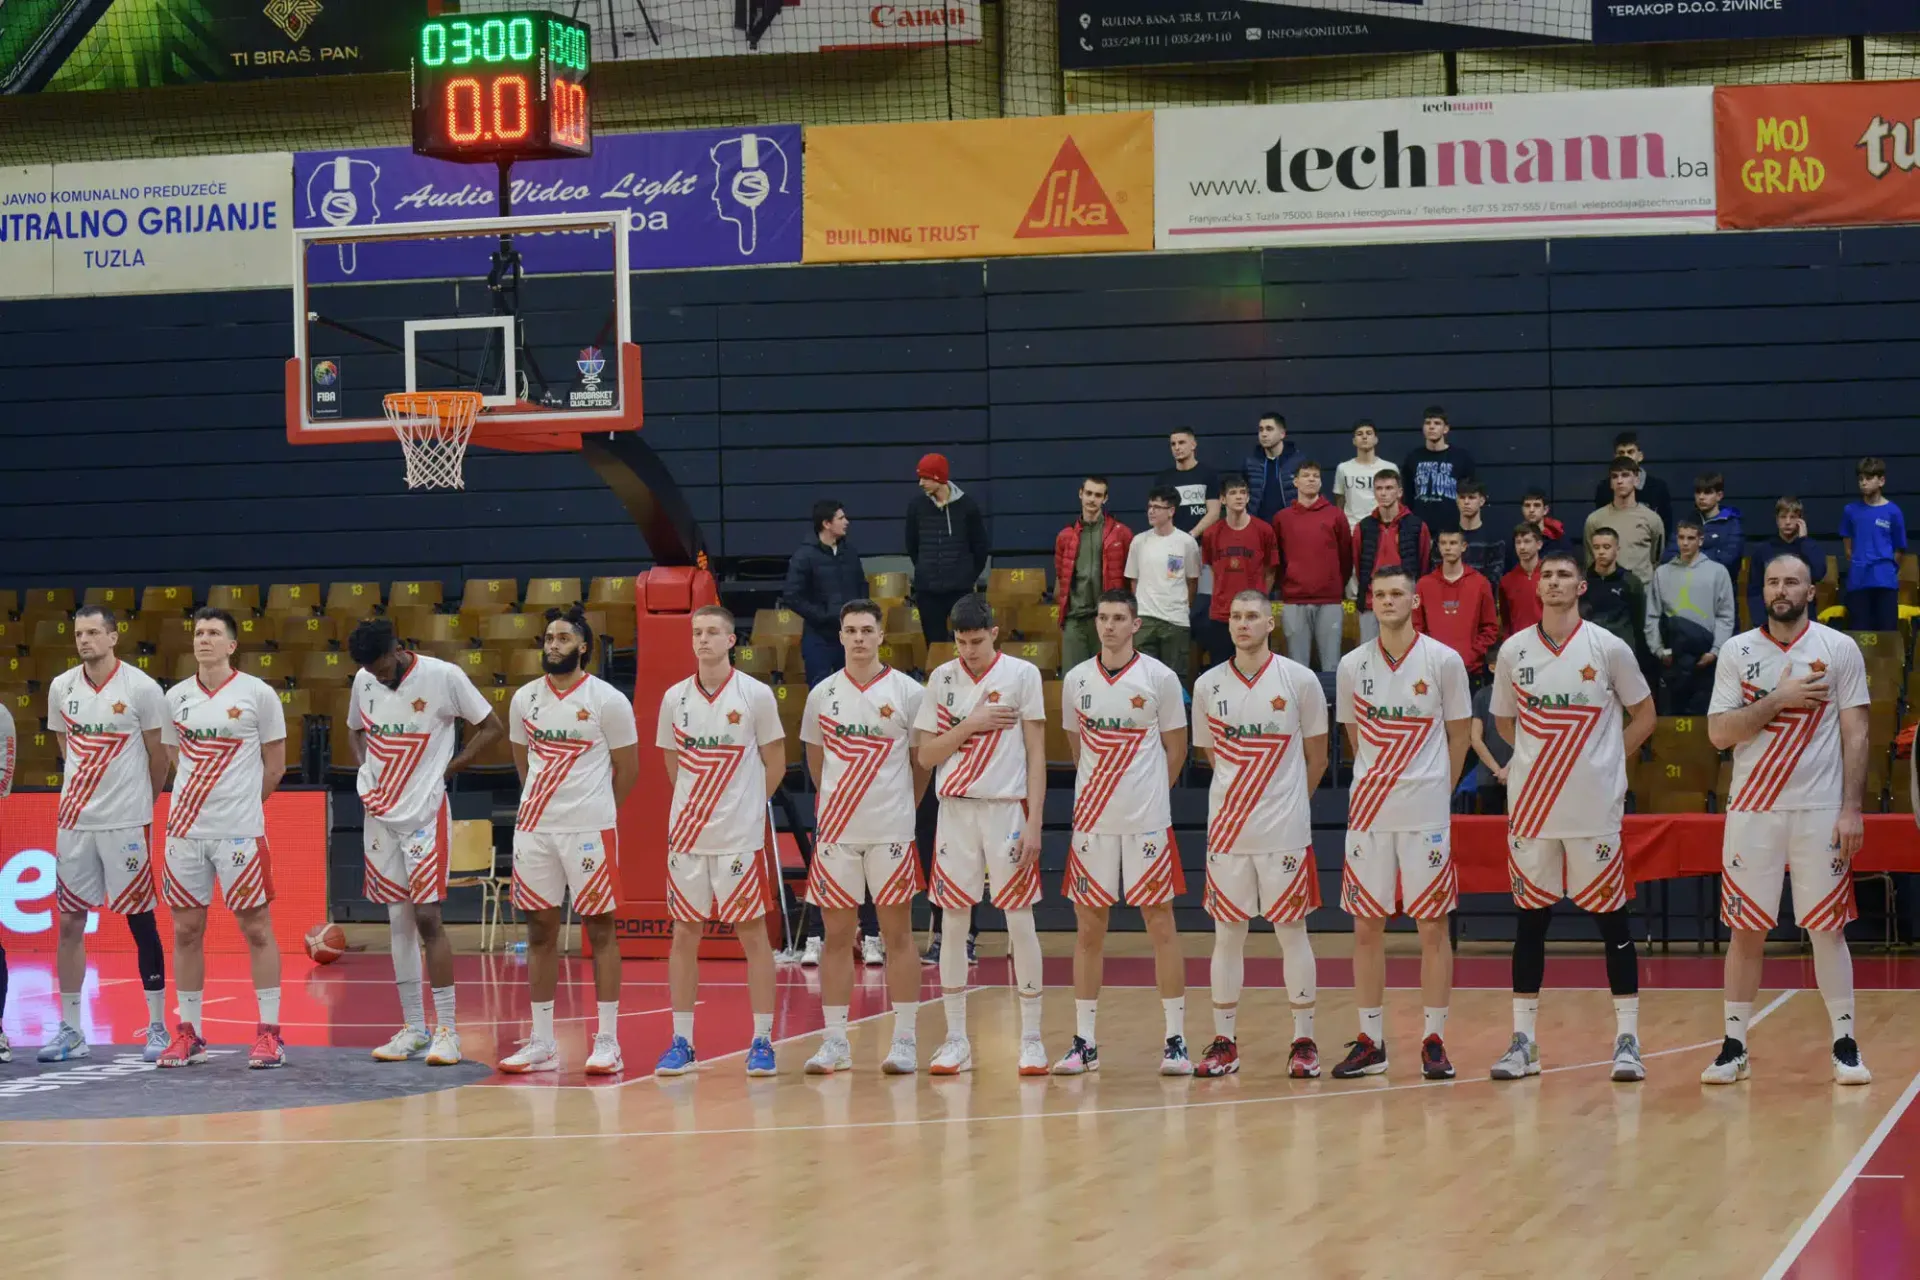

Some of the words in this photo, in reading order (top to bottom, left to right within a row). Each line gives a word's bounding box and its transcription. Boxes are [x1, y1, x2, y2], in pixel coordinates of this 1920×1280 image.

[871, 4, 965, 28] Canon
[1608, 4, 1674, 17] TERAKOP
[1101, 16, 1143, 27] KULINA
[1146, 14, 1176, 25] BANA
[1206, 11, 1241, 22] TUZLA
[422, 18, 532, 66] 03:00
[1171, 32, 1232, 44] 035/249-110
[230, 52, 249, 66] TI
[447, 76, 527, 141] 0.0
[1422, 101, 1494, 113] techmann
[1757, 115, 1809, 153] MOJ
[1741, 157, 1825, 194] GRAD
[2, 192, 46, 206] JAVNO
[51, 187, 140, 203] KOMUNALNO
[394, 184, 494, 210] Audio
[510, 179, 591, 205] Video
[600, 170, 698, 205] Light
[1029, 169, 1108, 228] Sika
[138, 201, 277, 237] GRIJANJE
[1353, 206, 1411, 219] Hercegovina
[825, 227, 912, 245] BUILDING
[917, 224, 980, 242] TRUST
[84, 248, 145, 269] TUZLA
[317, 391, 336, 402] FIBA
[570, 391, 613, 400] EUROBASKET
[1362, 679, 1373, 695] 12
[68, 701, 79, 714] 13
[1081, 694, 1092, 709] 10
[1217, 700, 1228, 716] 11
[1526, 694, 1569, 710] PAN
[1367, 706, 1403, 719] PAN
[71, 723, 103, 735] PAN
[370, 724, 404, 736] PAN
[835, 724, 869, 737] PAN
[1086, 717, 1121, 730] PAN
[1676, 719, 1692, 732] 31
[184, 728, 217, 740] PAN
[534, 729, 567, 741] PAN
[1224, 724, 1261, 739] PAN
[684, 736, 719, 749] PAN
[1727, 896, 1742, 915] 21
